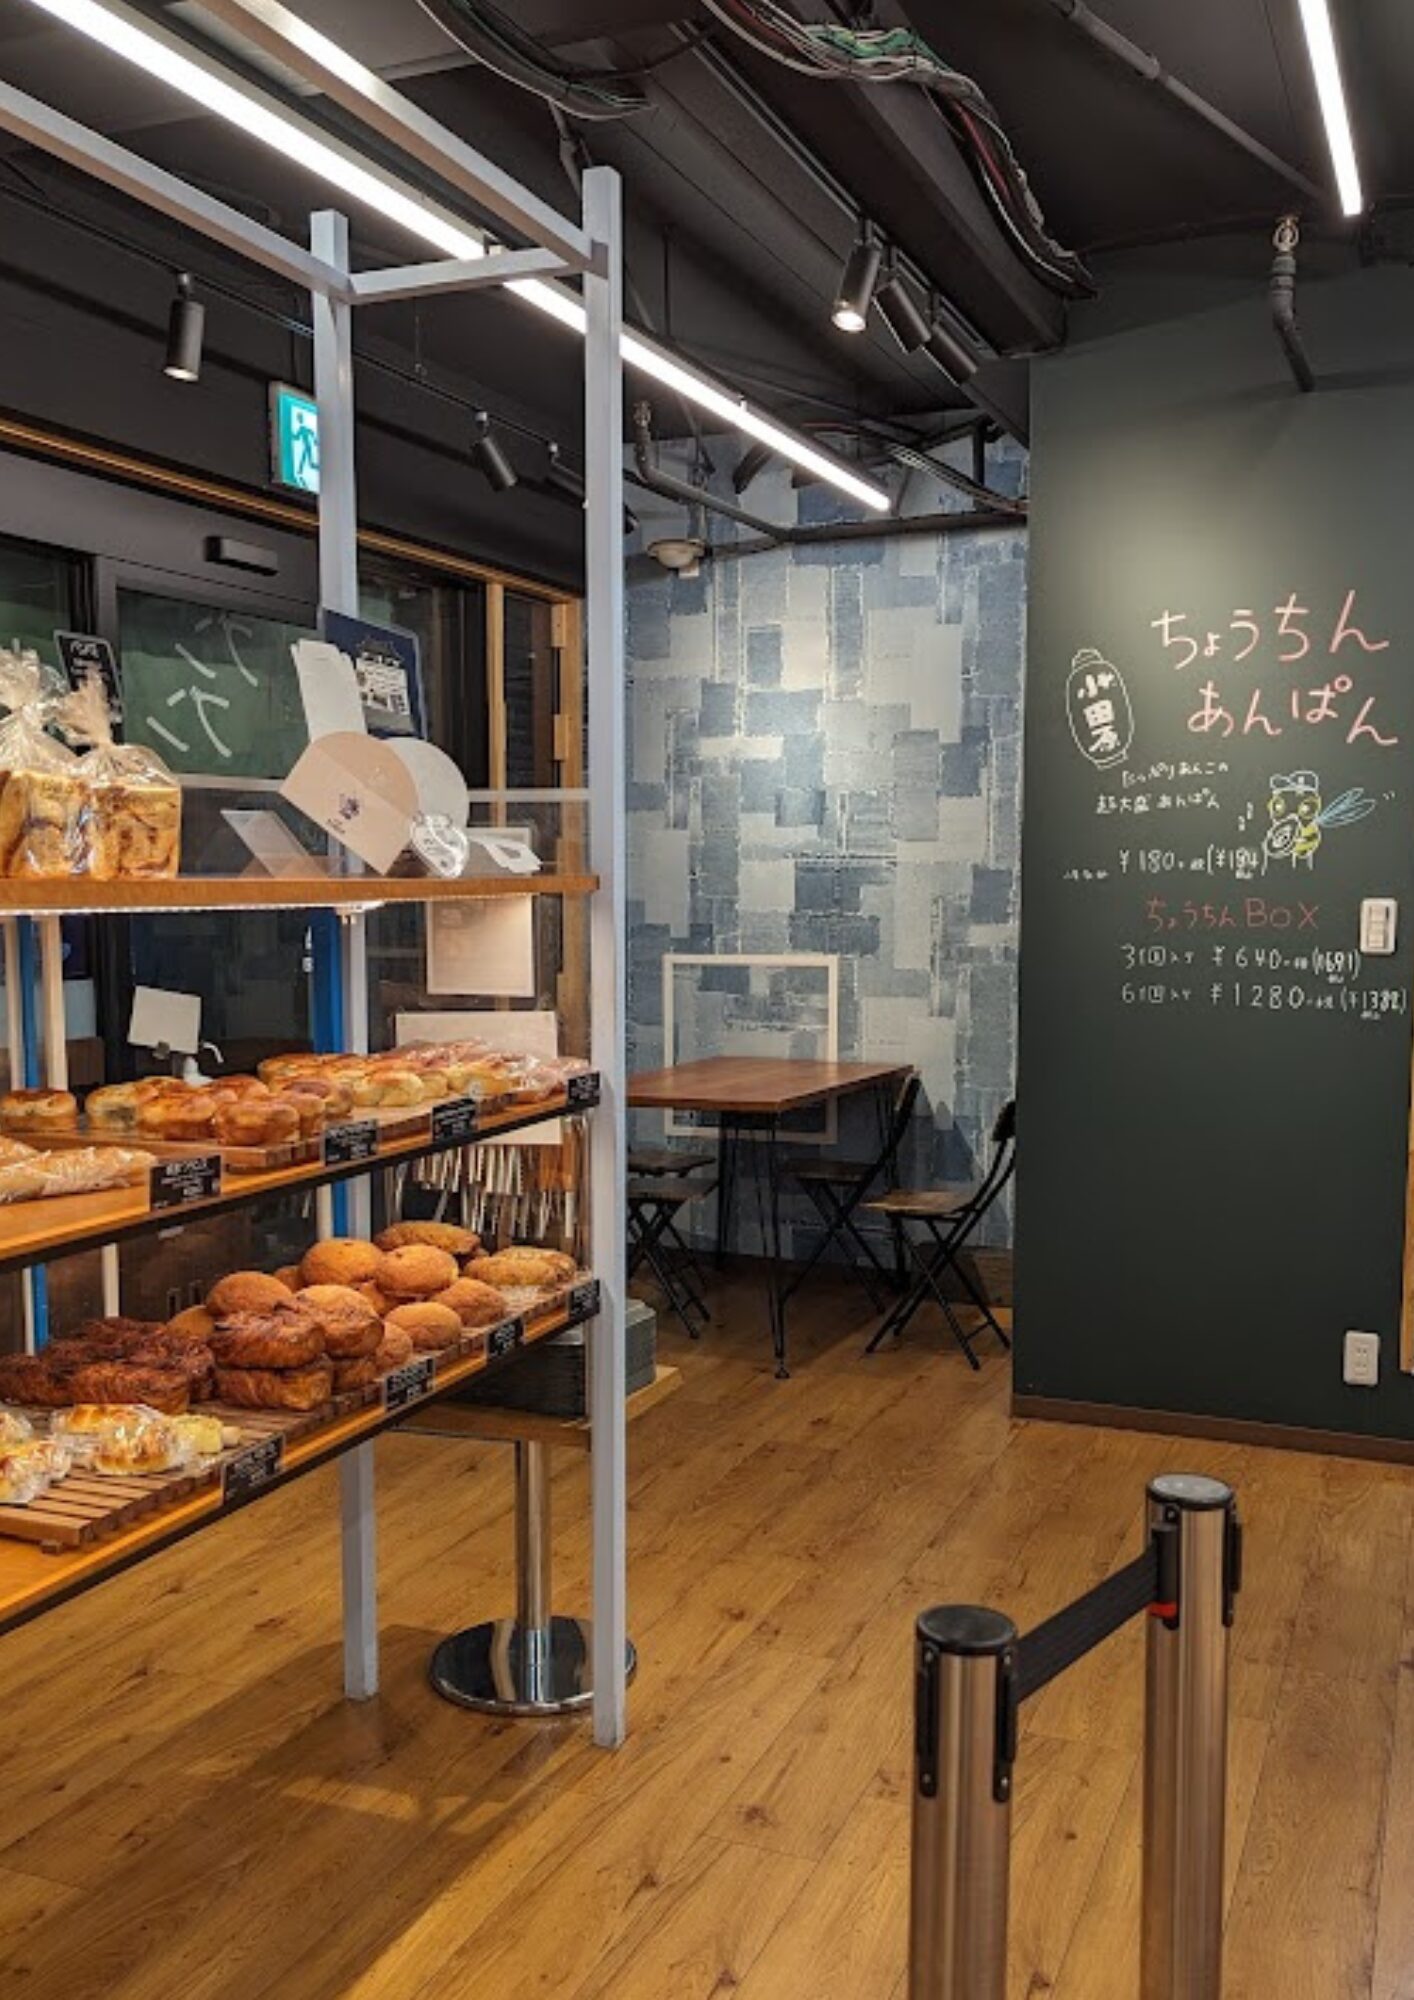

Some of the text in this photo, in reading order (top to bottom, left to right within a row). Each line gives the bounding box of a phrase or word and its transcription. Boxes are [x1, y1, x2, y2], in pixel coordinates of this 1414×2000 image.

[1151, 589, 1389, 670] ちょうちん
[1187, 674, 1398, 746] あんぱん
